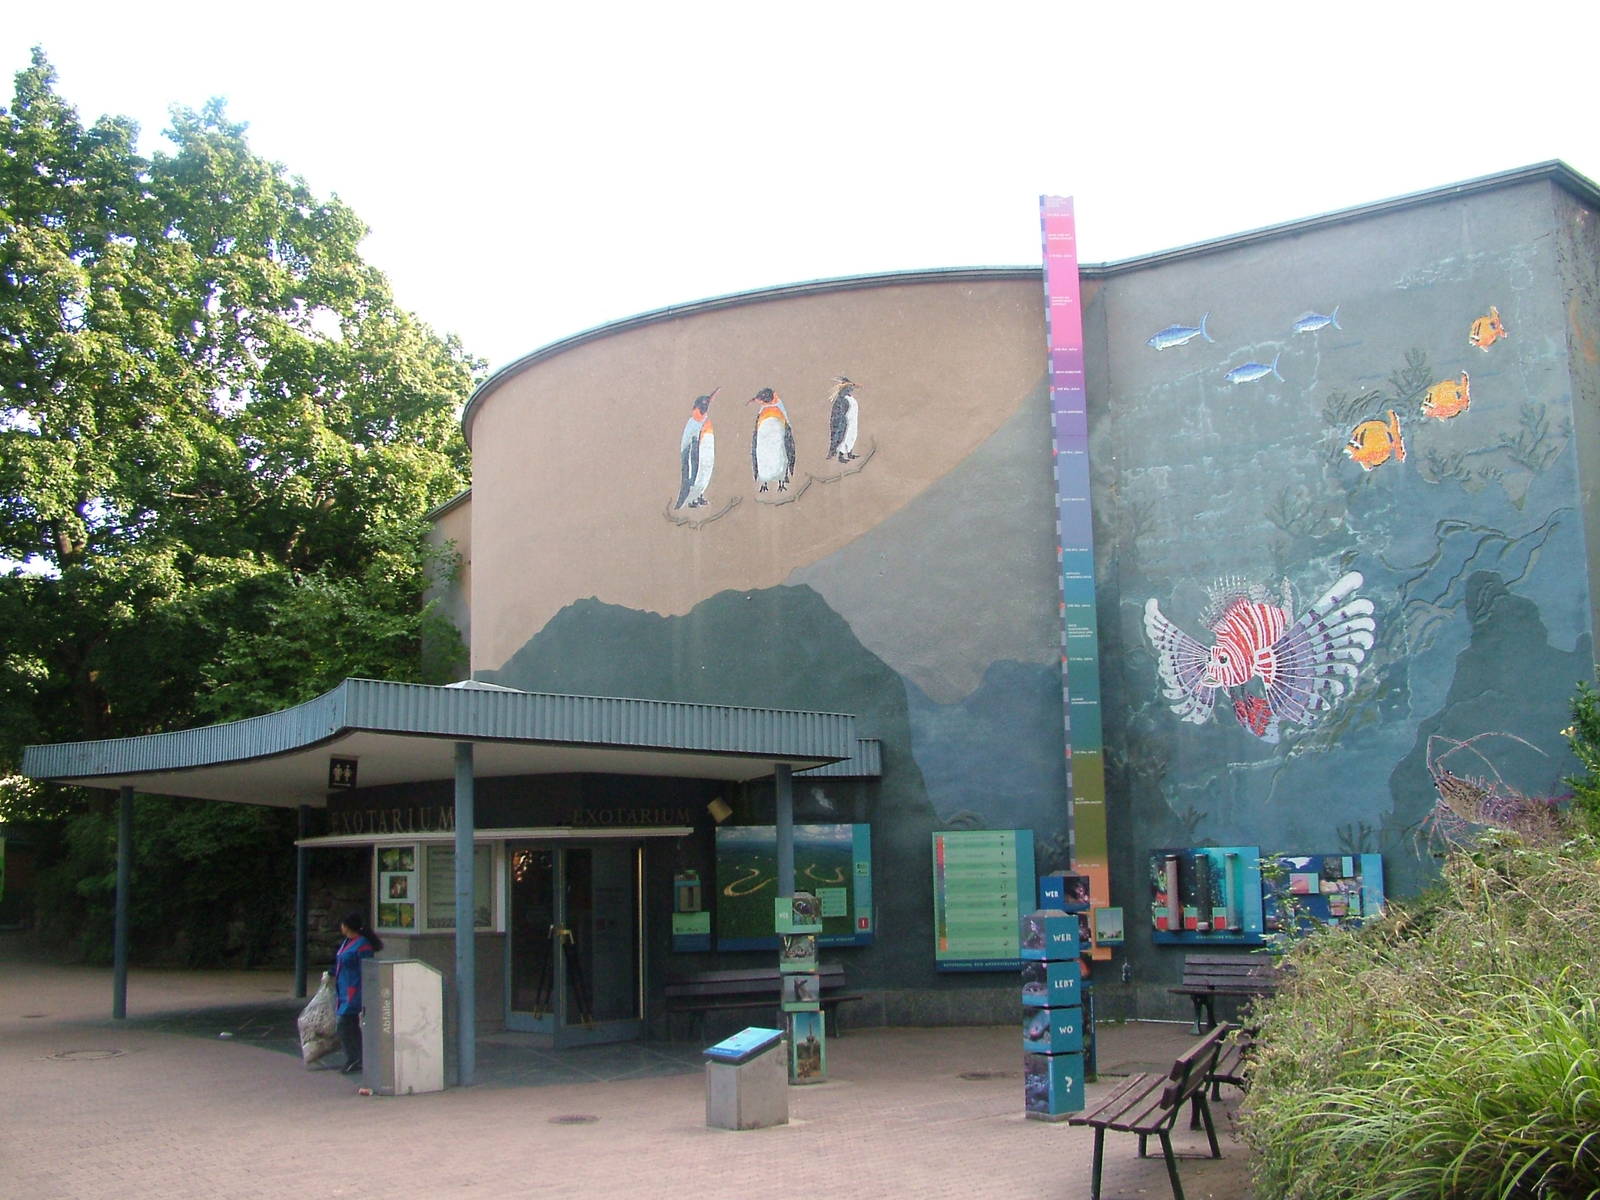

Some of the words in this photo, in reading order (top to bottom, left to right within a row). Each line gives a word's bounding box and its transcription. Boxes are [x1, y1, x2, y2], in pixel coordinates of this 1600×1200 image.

[332, 806, 454, 834] EXOTARIUM
[573, 809, 690, 825] EXOTARIUM
[1053, 934, 1072, 942] WER
[1054, 979, 1074, 988] LEBT
[1059, 1025, 1073, 1034] WO
[1064, 1076, 1073, 1093] ?
